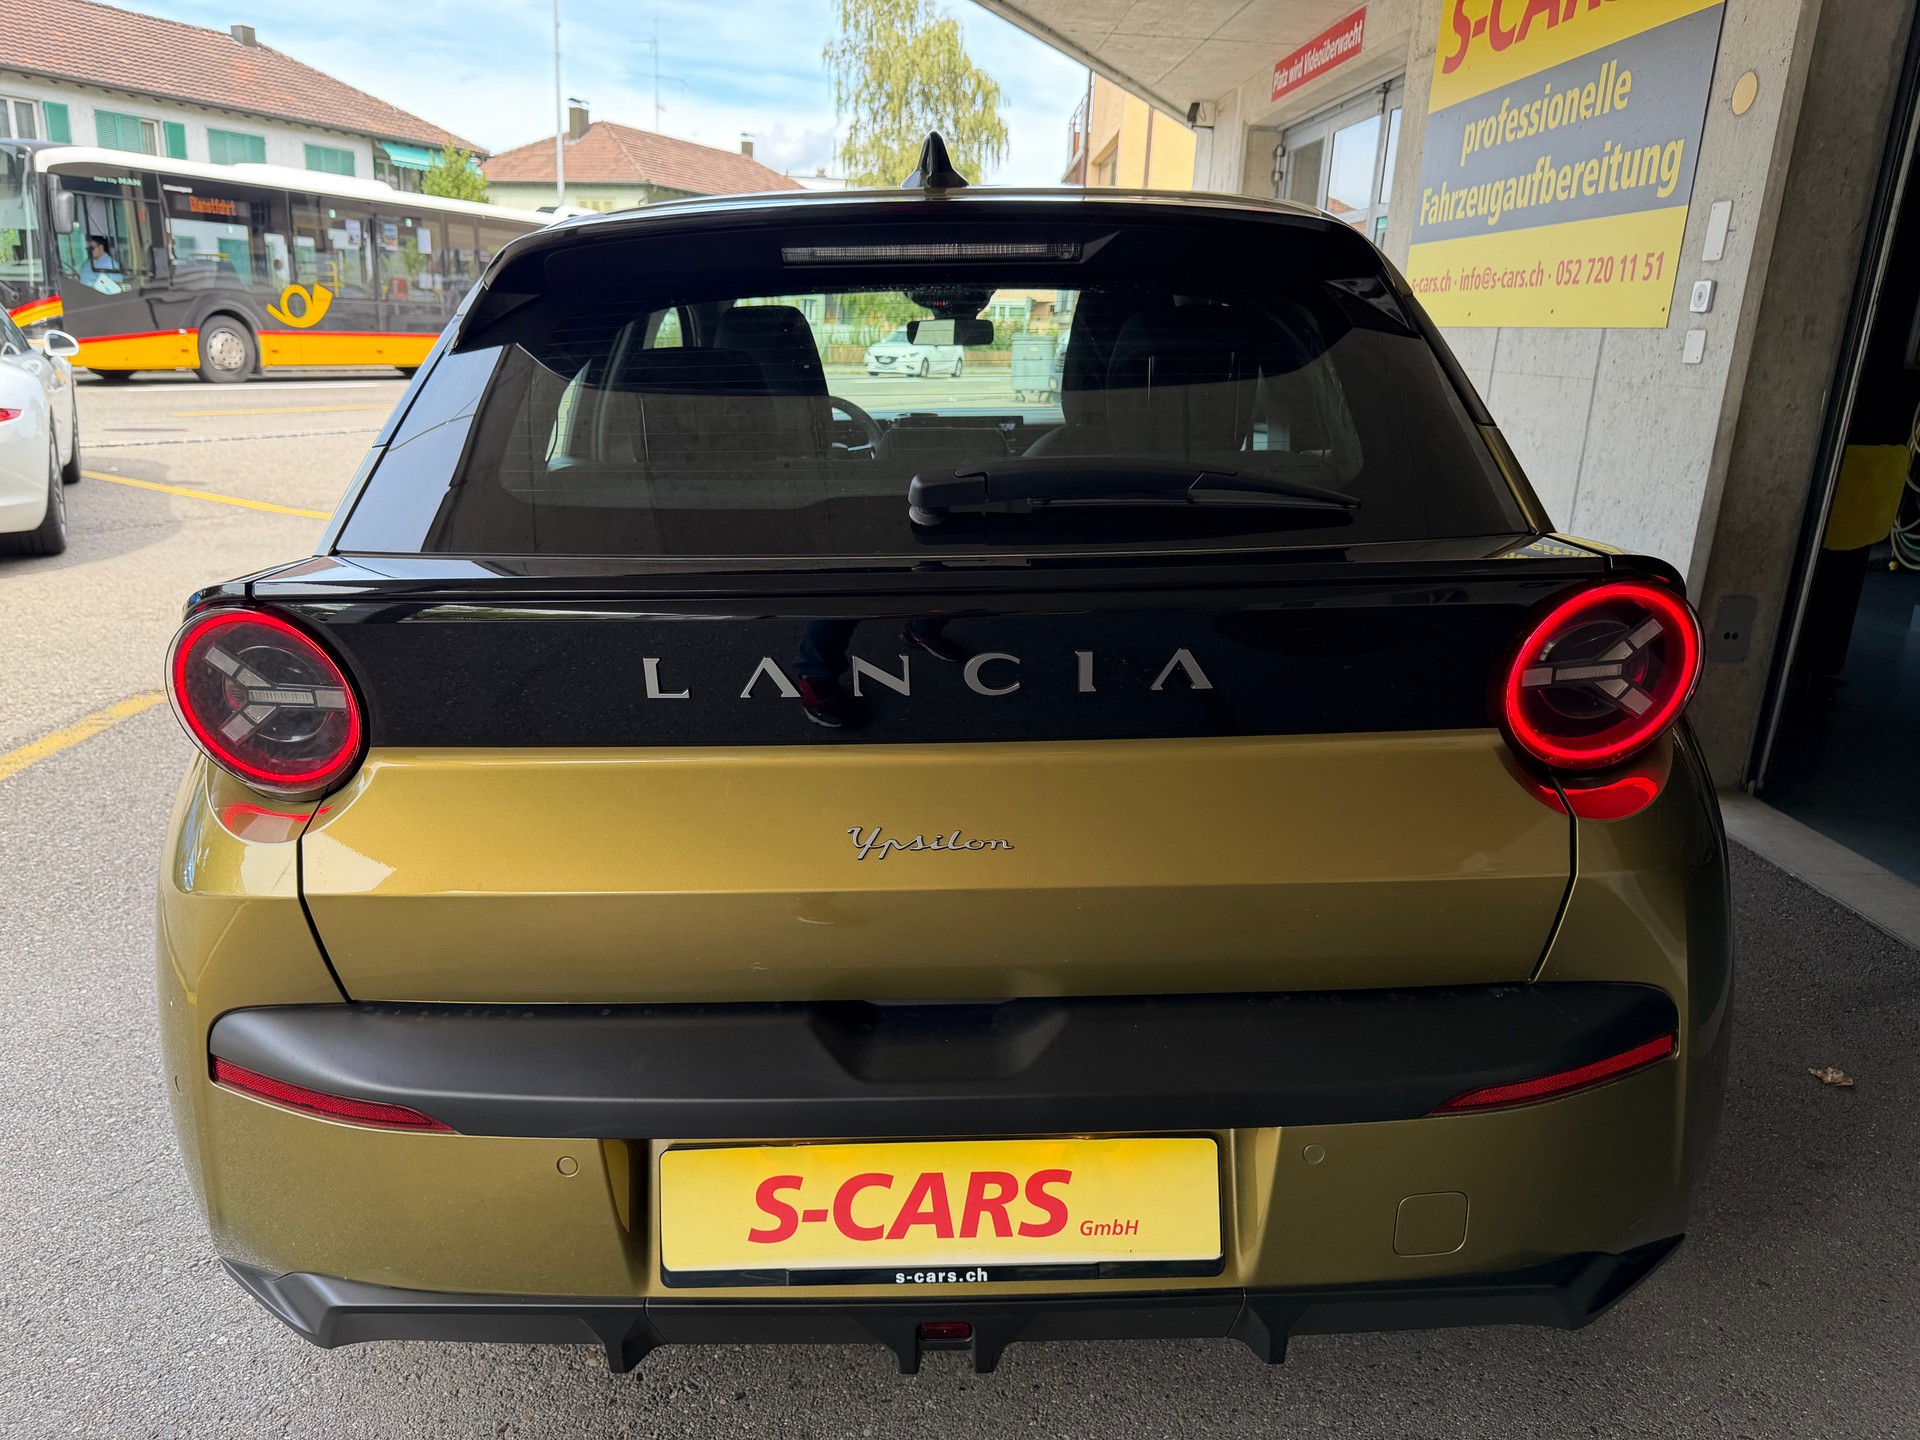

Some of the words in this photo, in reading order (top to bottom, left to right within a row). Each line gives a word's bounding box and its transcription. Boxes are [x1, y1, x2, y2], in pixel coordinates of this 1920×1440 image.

[1272, 68, 1289, 93] Platz
[1288, 55, 1304, 84] wird
[1303, 19, 1363, 76] Videoüberwacht
[1460, 59, 1632, 167] professionelle
[1419, 139, 1685, 226] Fahrzeugaufbereitung
[1459, 261, 1544, 292] info@s-cars.ch
[1555, 259, 1583, 287] 052
[1585, 255, 1614, 285] 720
[1620, 253, 1638, 282] 11
[1642, 251, 1665, 282] 51
[642, 647, 1214, 699] LANCIA
[847, 826, 1015, 860] Ypsilon
[747, 1168, 1073, 1244] S-CARS
[1079, 1219, 1140, 1237] GmbH
[895, 1267, 989, 1284] s-cars.ch
